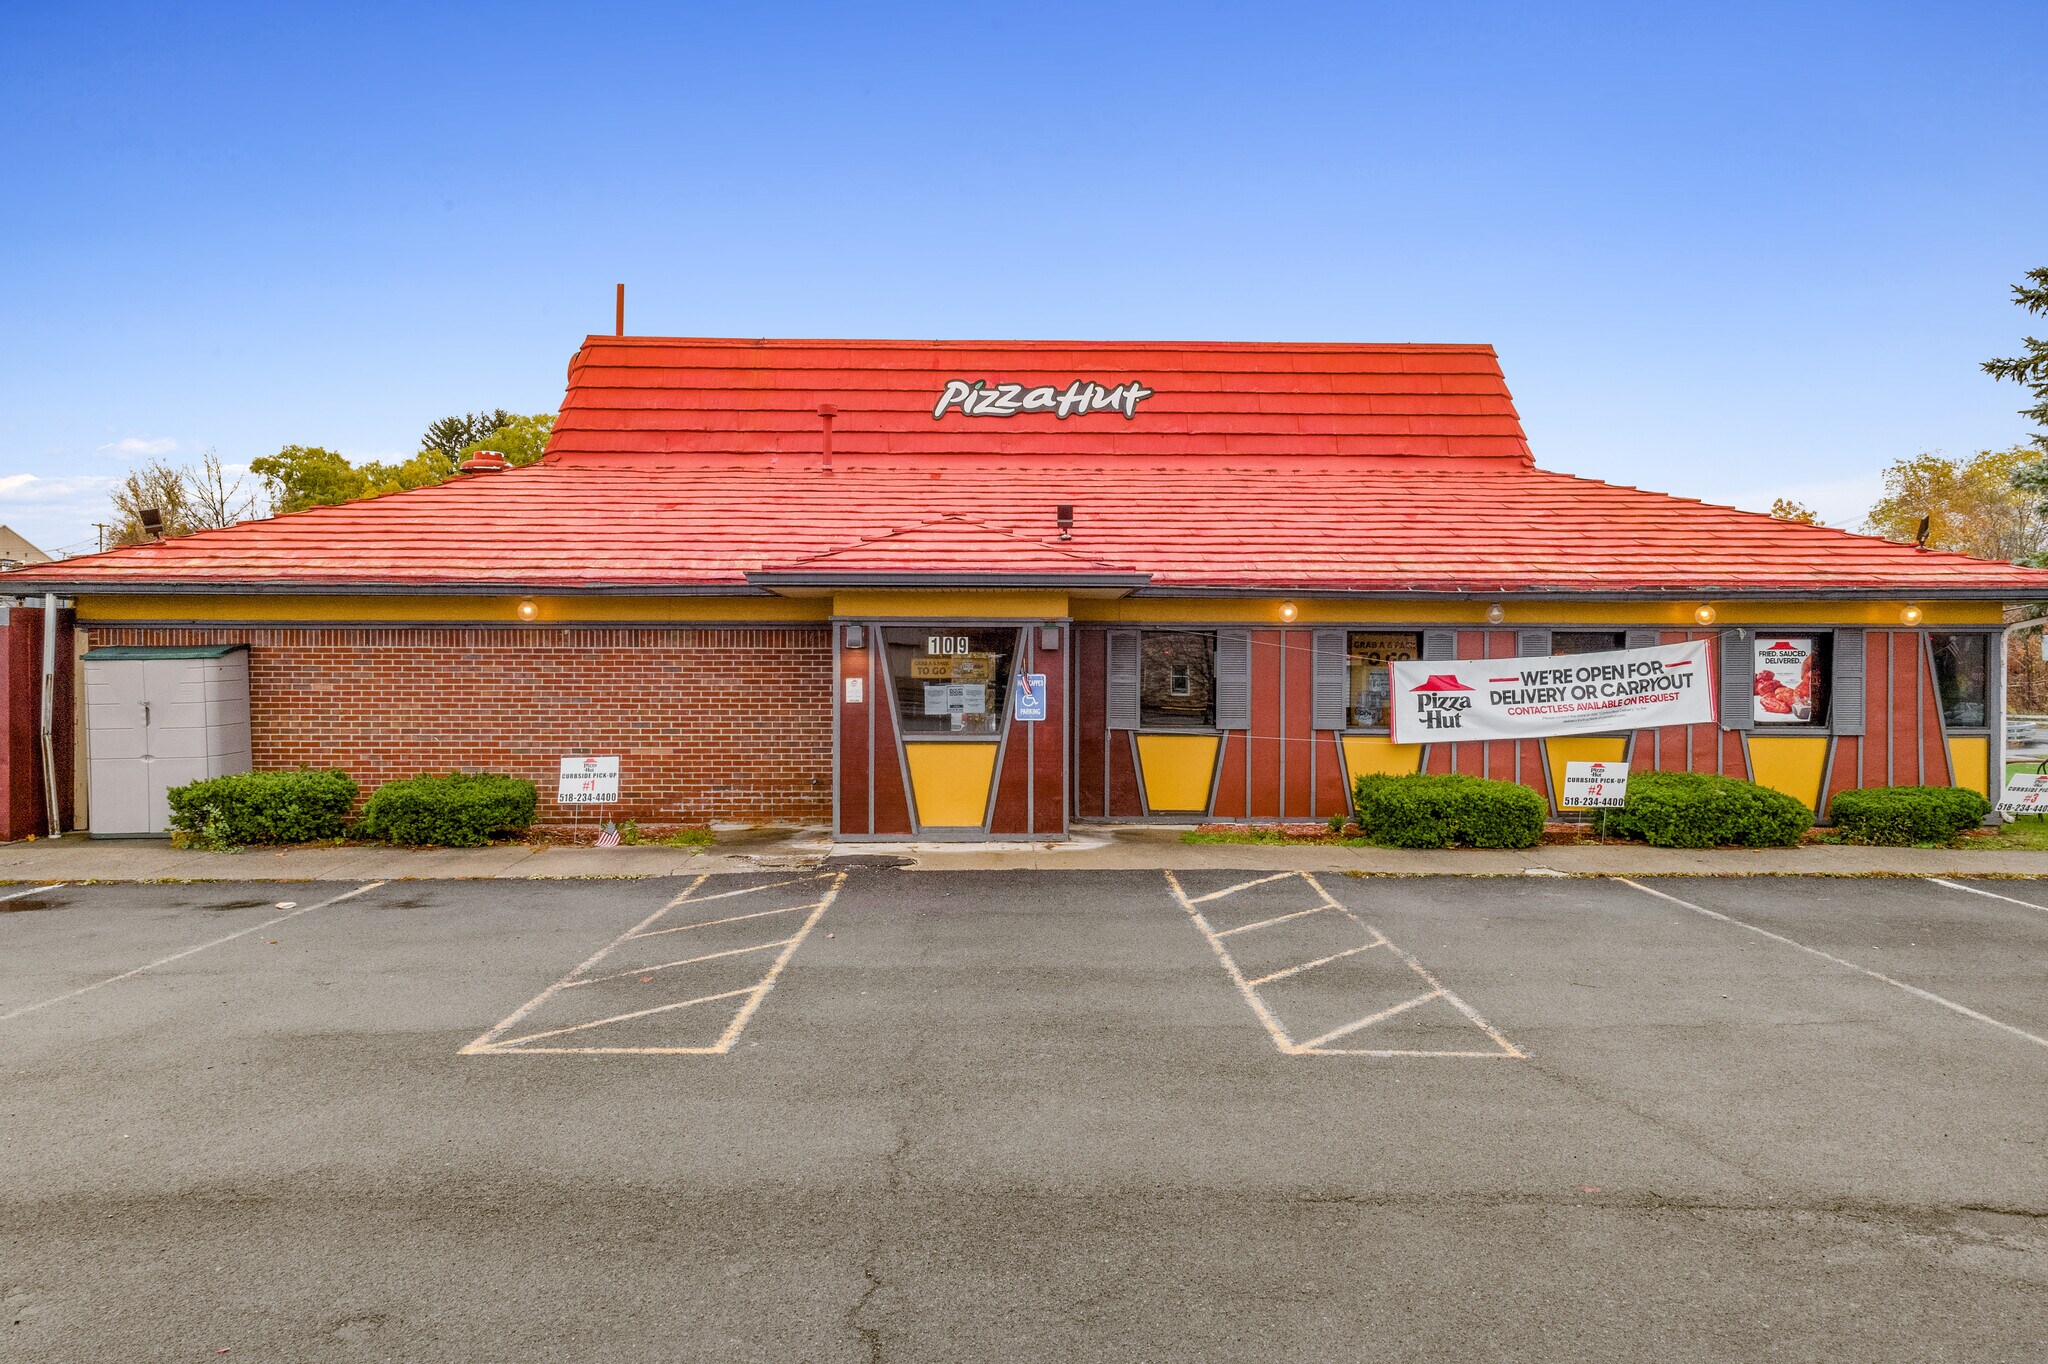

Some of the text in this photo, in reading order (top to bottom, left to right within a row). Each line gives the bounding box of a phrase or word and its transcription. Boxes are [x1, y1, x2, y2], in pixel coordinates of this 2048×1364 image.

[933, 381, 1151, 417] Pizza Hut
[930, 637, 967, 654] 109
[1353, 641, 1377, 649] GRAB
[1379, 641, 1386, 649] A
[1358, 651, 1381, 666] TO
[917, 666, 947, 675] TO GO
[1520, 660, 1664, 686] WE'RE OPEN FOR
[1489, 672, 1694, 706] DELIVERY OR CARRYOUT
[1417, 692, 1472, 712] Pizza
[1507, 703, 1575, 716] CONTACTLESS
[1576, 698, 1623, 711] AVAILABLE
[1623, 696, 1637, 706] ON
[1638, 691, 1680, 704] REQUEST
[1418, 710, 1462, 729] Hut
[582, 780, 595, 791] #1
[1588, 784, 1602, 796] #2
[560, 792, 616, 802] 518-234-4400
[1564, 797, 1624, 806] 518-234-4400
[2024, 793, 2039, 803] #3
[1998, 803, 2048, 812] 518-234-440
